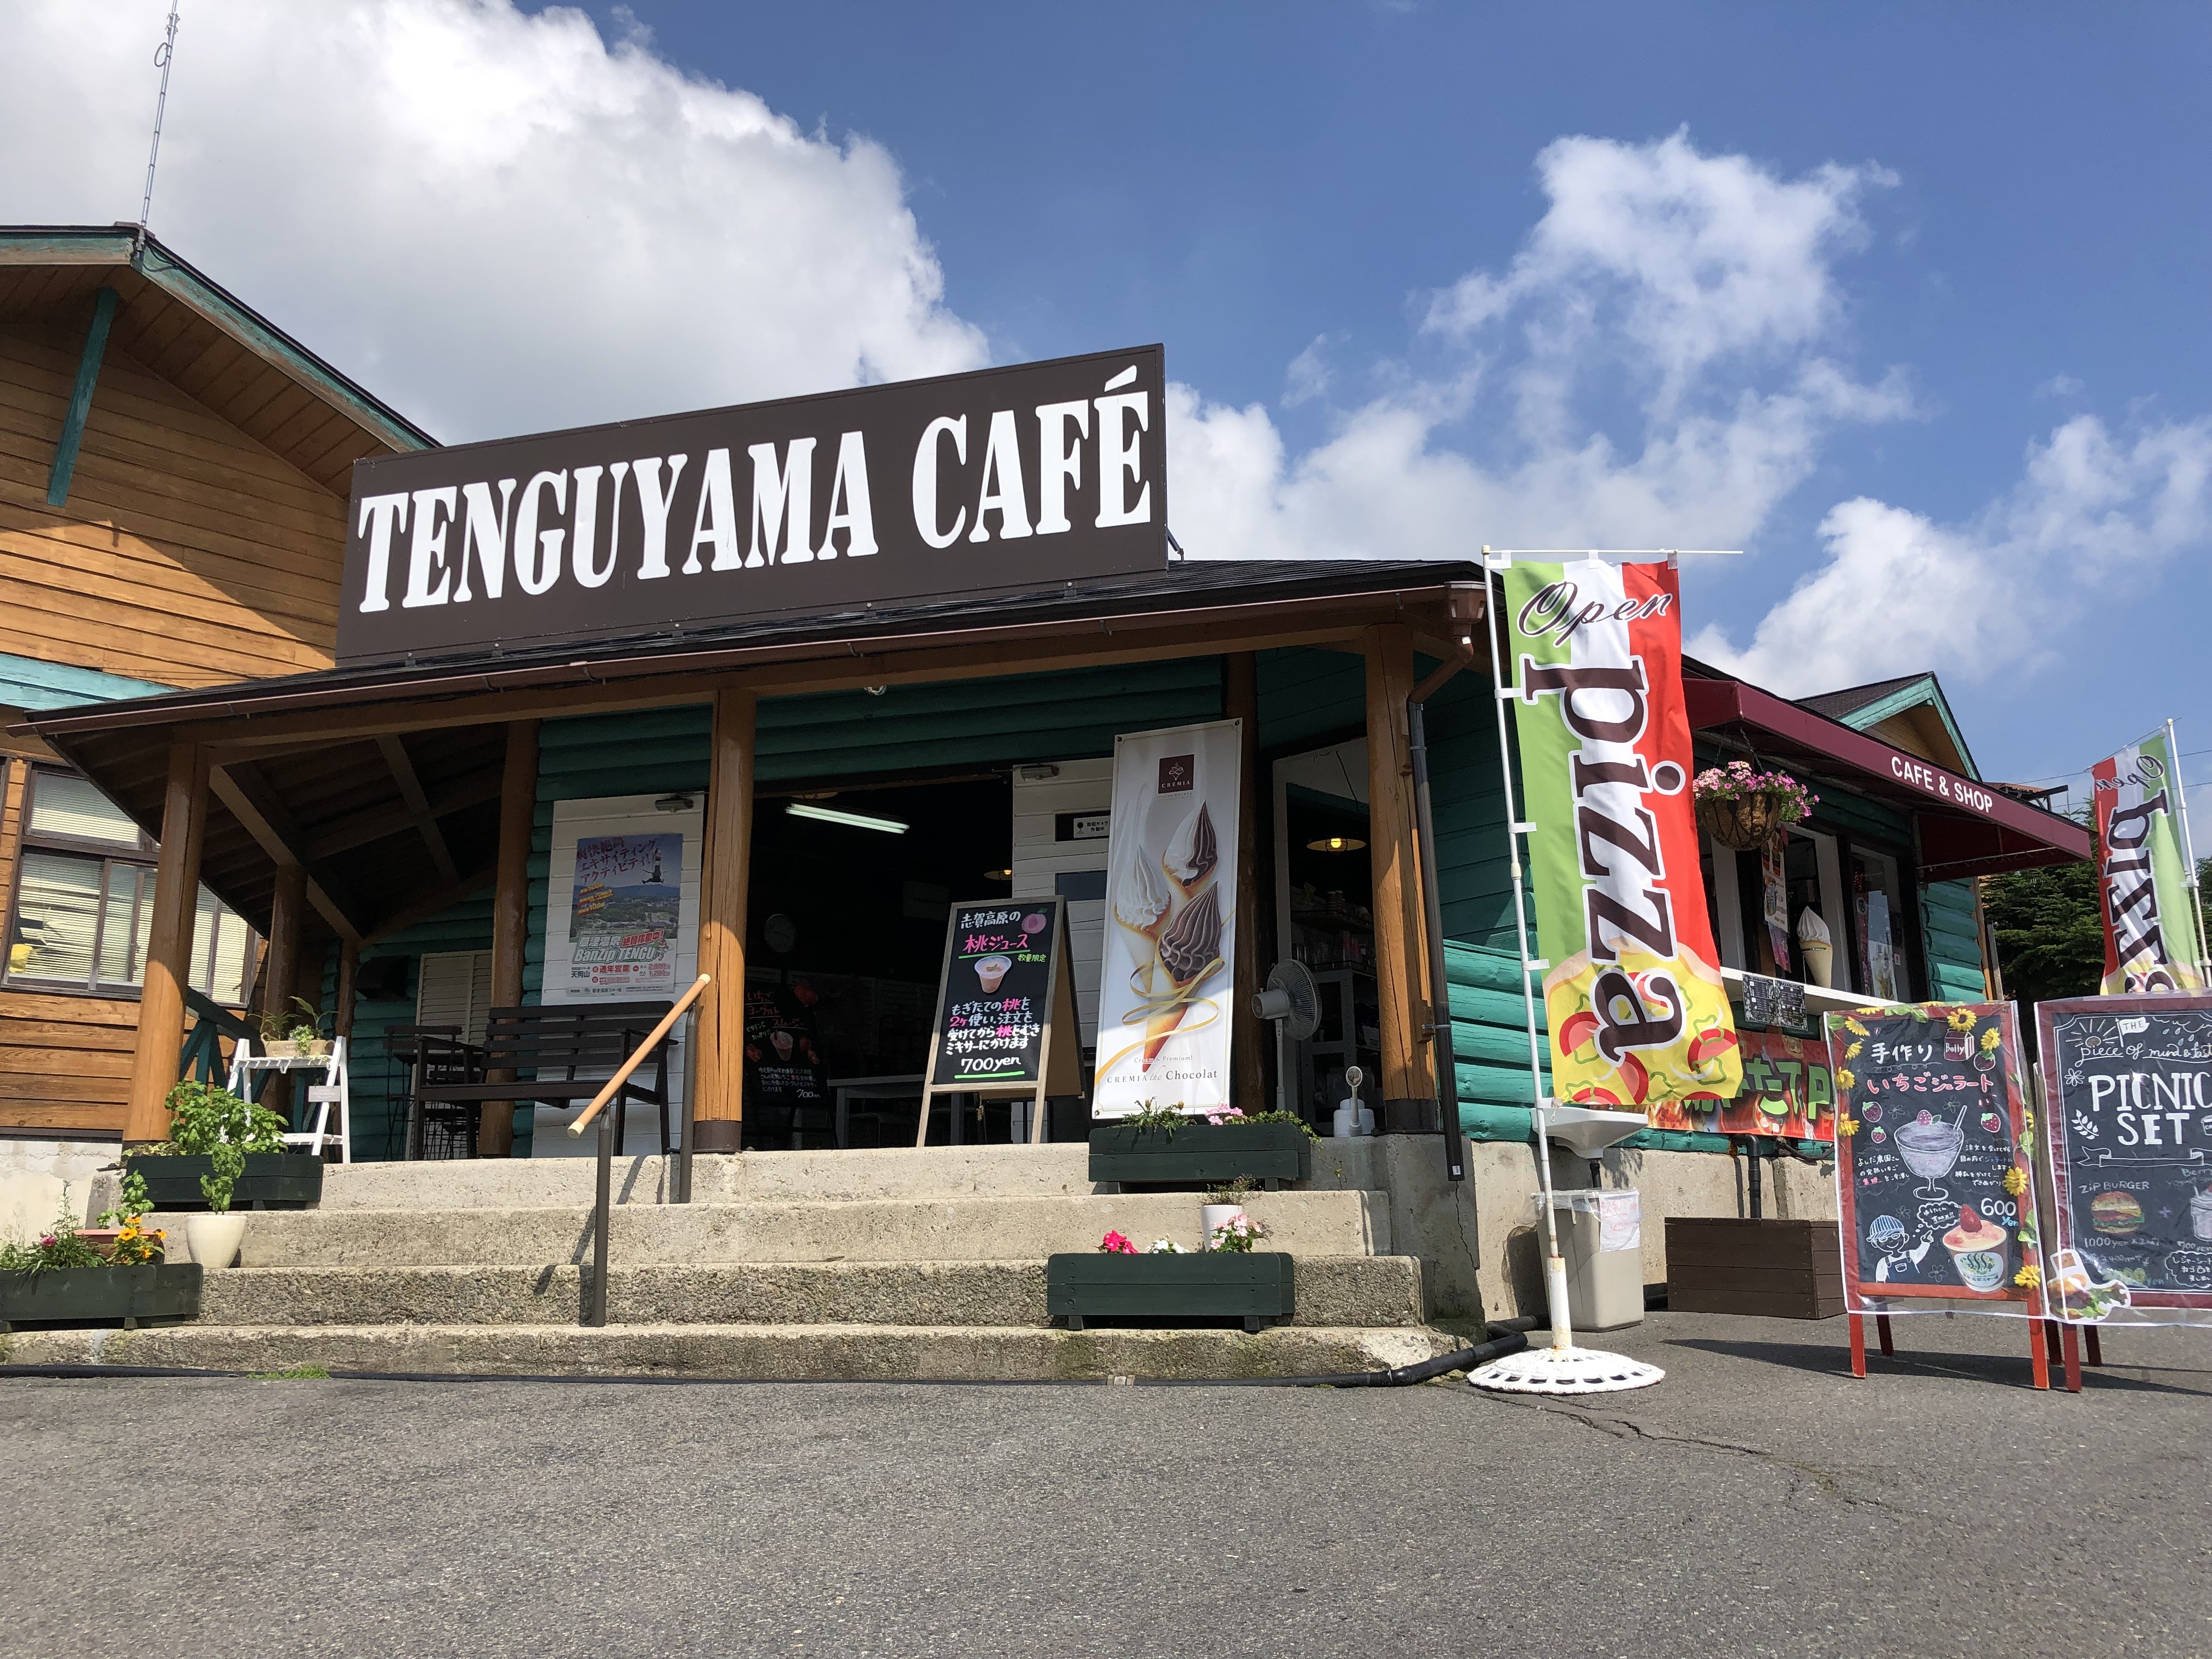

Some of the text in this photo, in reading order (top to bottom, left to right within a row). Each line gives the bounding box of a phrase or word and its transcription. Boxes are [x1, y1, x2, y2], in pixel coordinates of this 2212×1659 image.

[358, 365, 1151, 613] TENGUYAMA CAFÉ
[1519, 581, 1671, 646] Open
[1161, 780, 1190, 788] CREMIA
[1891, 756, 1993, 813] CAFE & SHOP
[580, 838, 658, 872] エキサイティング
[1524, 658, 1686, 1062] pizza
[961, 911, 1021, 929] 志賀高原の
[577, 935, 622, 947] 草津温泉
[963, 934, 1029, 953] 桃ジュース
[574, 946, 656, 963] BanZip TENGU
[1017, 953, 1047, 962] 数量限定
[952, 996, 1031, 1016] もぎたての桃を
[947, 1024, 1040, 1042] 受けてから桃をむき
[2123, 1020, 2145, 1030] THE
[946, 1036, 1029, 1056] ミキサーにかけます
[1871, 1042, 1932, 1064] 手作り
[2075, 1045, 2124, 1068] piece
[1149, 1065, 1166, 1081] the
[1166, 1069, 1218, 1081] Chocolat
[2088, 1071, 2212, 1111] PICNIC
[2118, 1111, 2190, 1146] SET
[1981, 1198, 2017, 1216] 600
